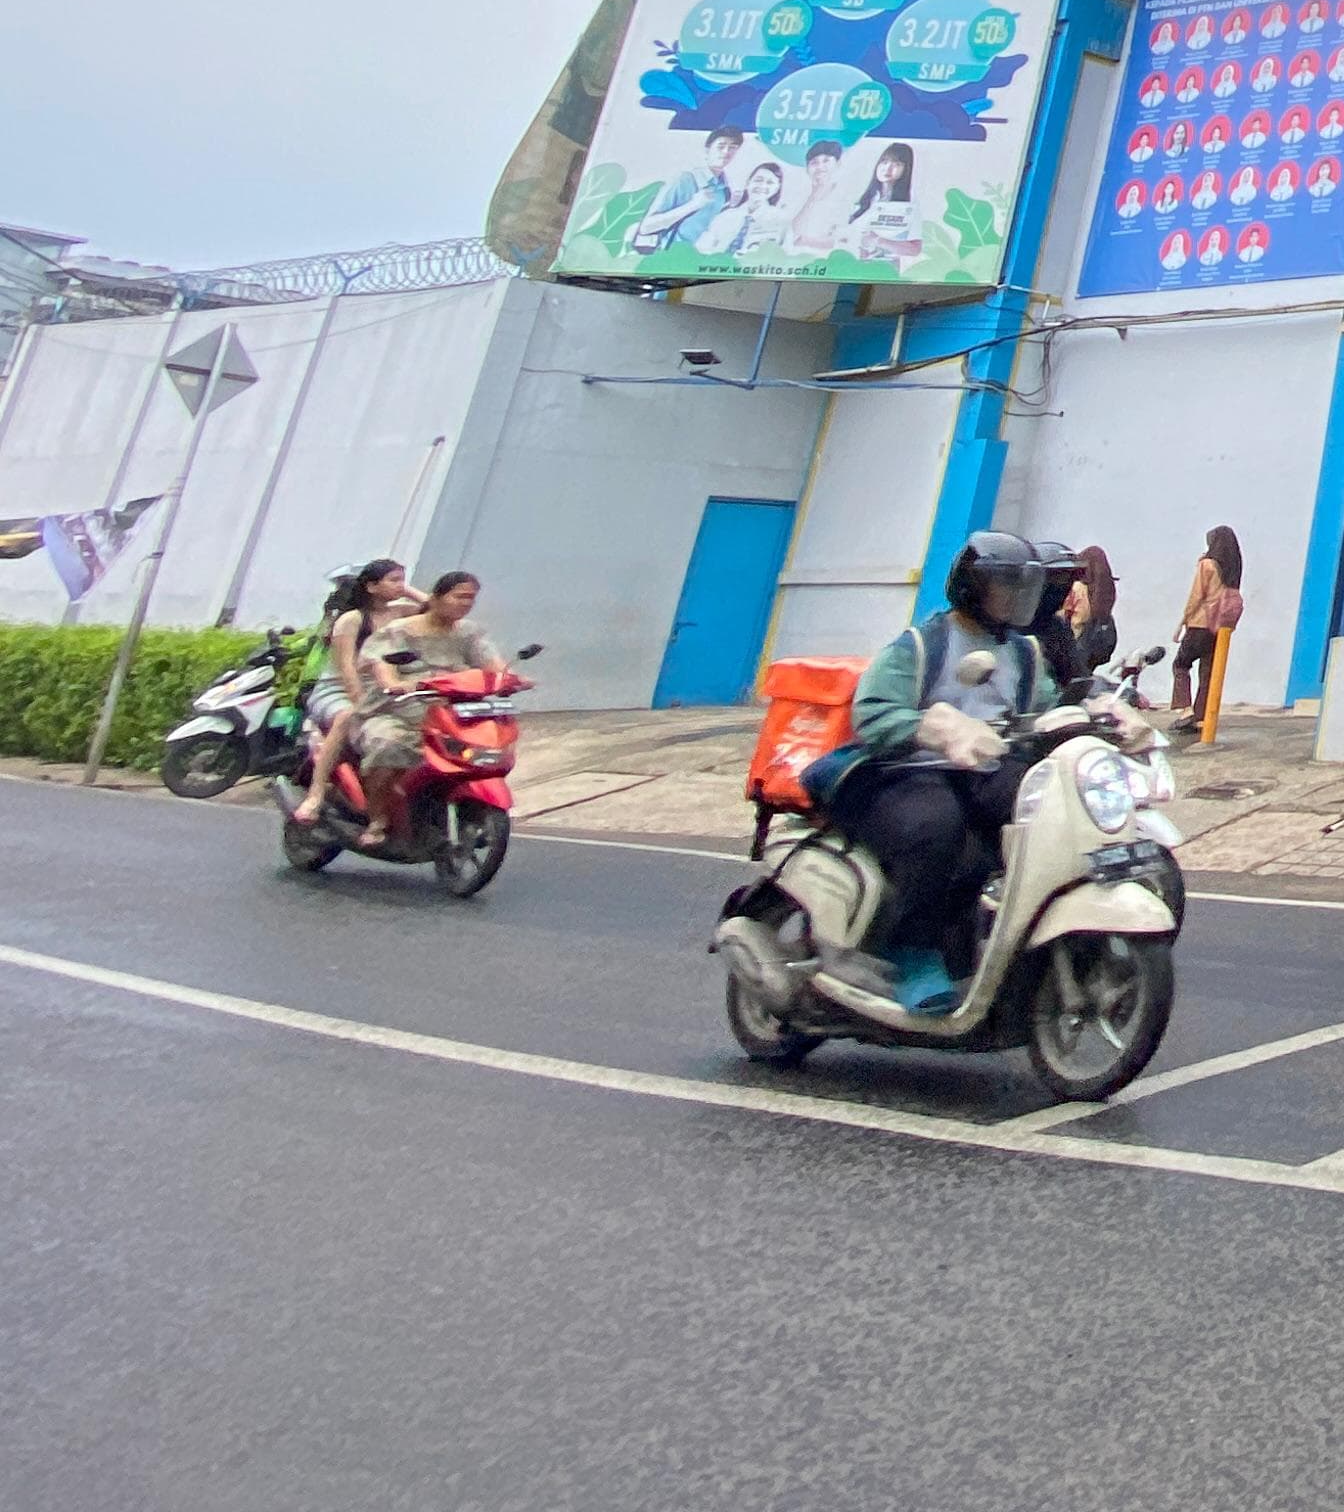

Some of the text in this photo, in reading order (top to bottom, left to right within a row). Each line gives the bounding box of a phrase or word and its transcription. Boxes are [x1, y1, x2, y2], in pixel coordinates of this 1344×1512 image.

[693, 7, 764, 40] 3.1JT
[900, 18, 968, 50] 3.2JT
[706, 52, 744, 71] SMK
[918, 63, 957, 81] SMP
[773, 89, 843, 122] 3.5JT
[770, 127, 810, 146] SMA
[698, 263, 827, 277] www.waskito.sch.id
